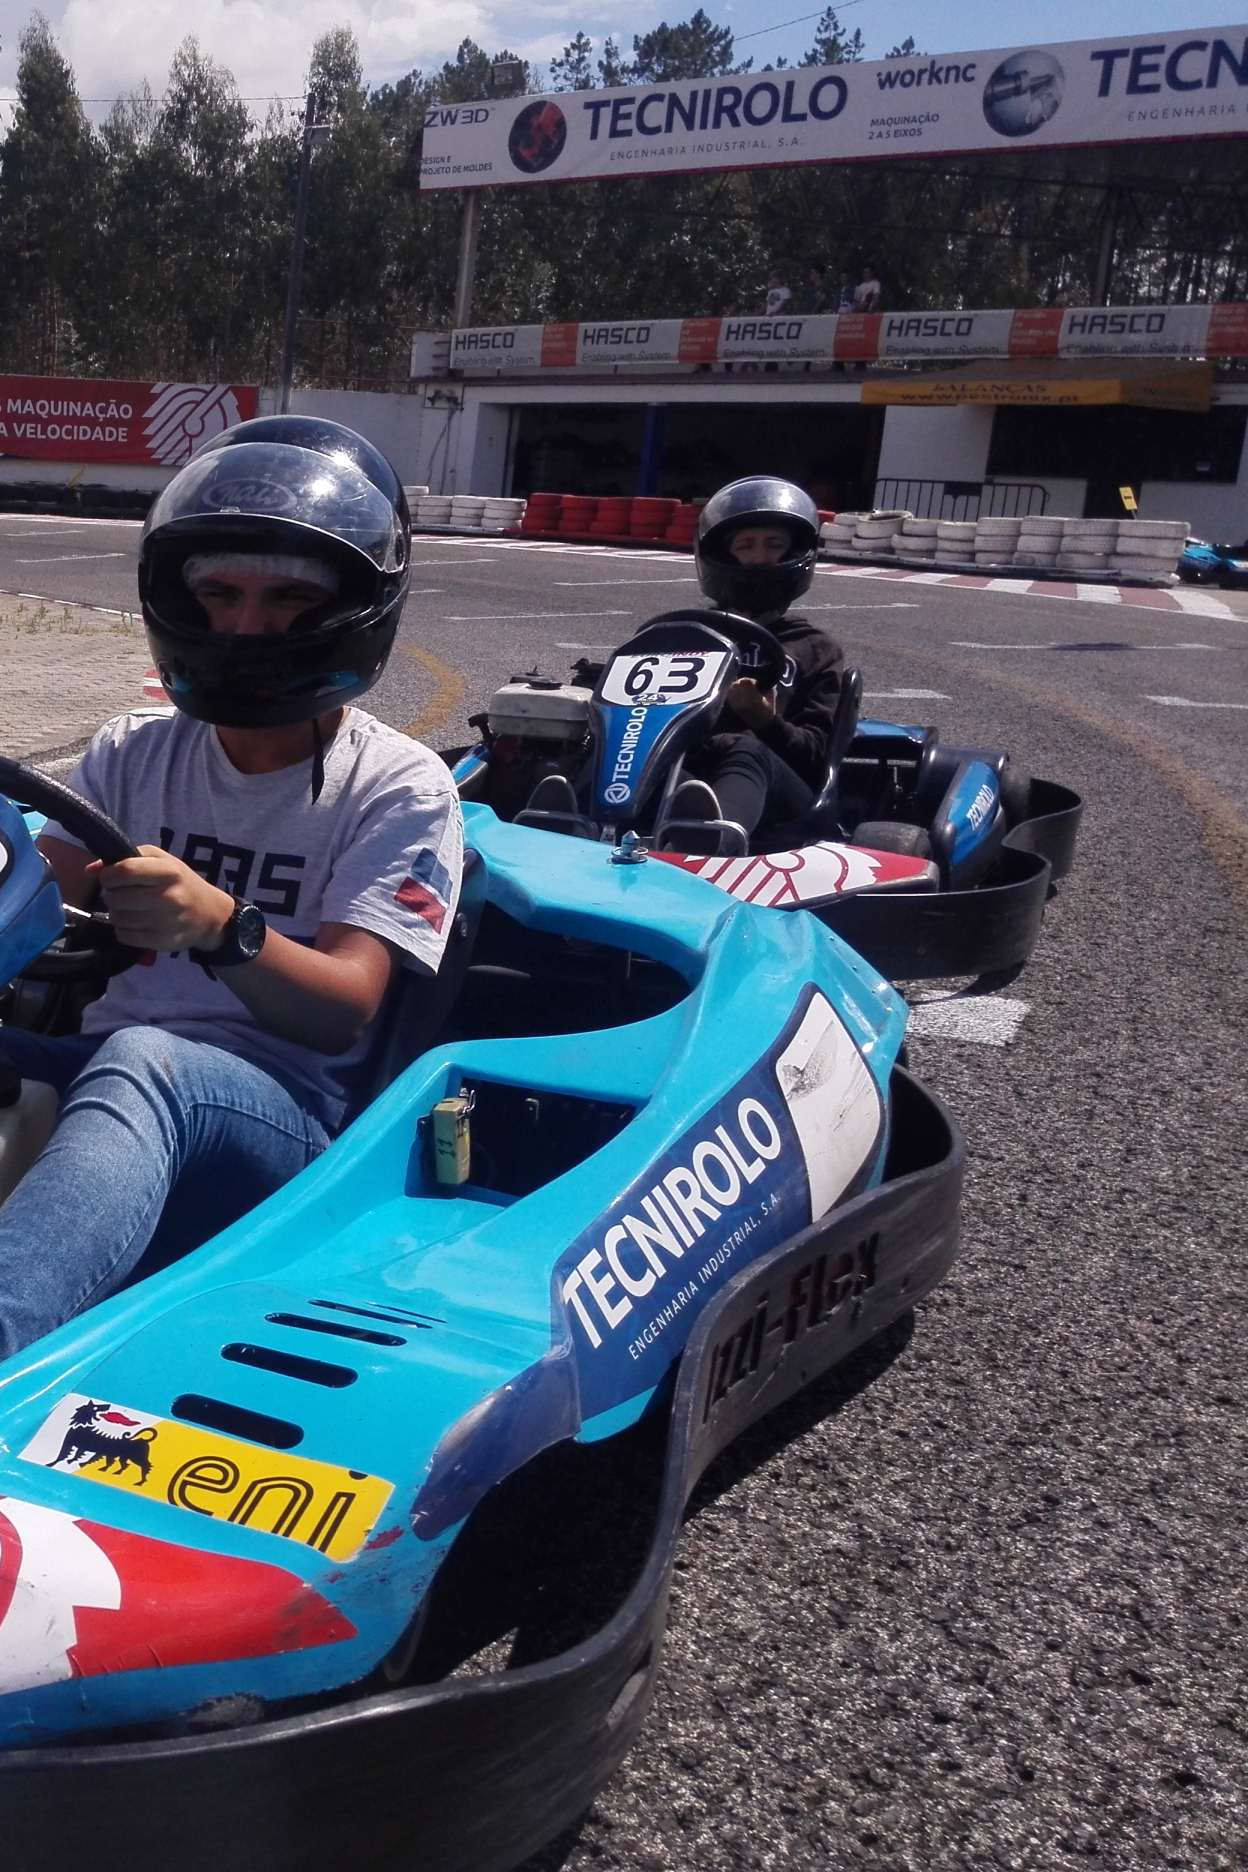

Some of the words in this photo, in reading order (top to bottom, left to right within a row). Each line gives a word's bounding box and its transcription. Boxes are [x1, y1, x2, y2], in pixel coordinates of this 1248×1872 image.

[877, 59, 977, 90] worknc
[583, 75, 848, 141] TECNIROLO
[1127, 103, 1237, 121] ENGENHARIA
[870, 112, 940, 126] MAQUINAÇÃO
[610, 146, 686, 161] ENGENHARIA
[725, 322, 803, 341] HASCO
[886, 317, 973, 337] HASCO
[1068, 313, 1166, 334] HASCO
[455, 332, 515, 351] HASCO
[583, 326, 650, 346] HASCO
[7, 398, 133, 421] MAQUINAÇÃO
[12, 422, 128, 442] VELOCIDADE
[624, 657, 706, 697] 63
[612, 706, 648, 783] TECNIROLO
[561, 1097, 782, 1349] TECNIROLO
[628, 1280, 698, 1360] ENGENHARIA
[167, 1455, 368, 1553] eni
